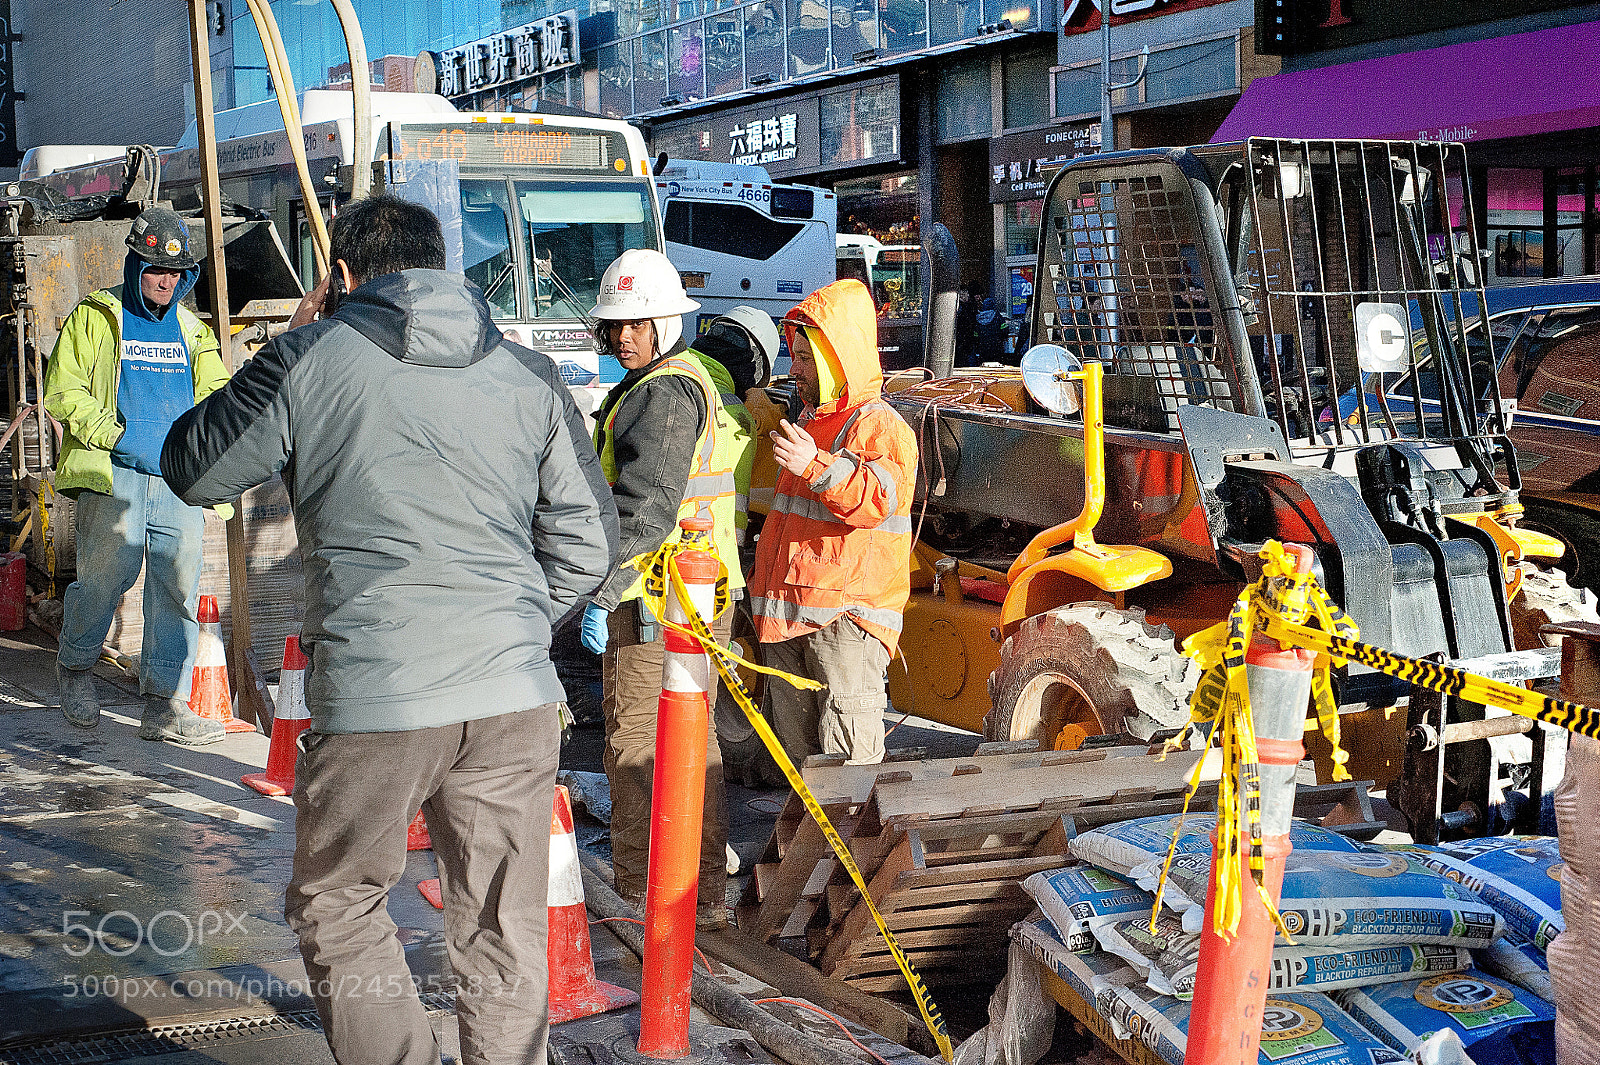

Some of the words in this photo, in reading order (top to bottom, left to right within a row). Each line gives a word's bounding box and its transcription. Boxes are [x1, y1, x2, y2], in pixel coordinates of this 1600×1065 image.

[440, 15, 569, 96] 新世界商城
[493, 130, 572, 149] LAGUARDIA
[729, 113, 797, 156] 六福珠寶
[237, 142, 261, 161] Electric
[263, 140, 276, 156] Bus
[503, 149, 563, 164] AIRPORT
[759, 147, 797, 164] JEWELLERY
[709, 187, 721, 195] City
[738, 189, 770, 202] 4666
[604, 284, 616, 295] GEI
[1101, 893, 1145, 908] HIGH
[1307, 908, 1348, 937] HP
[1354, 910, 1443, 924] ECO-FRIENDLY
[1352, 924, 1394, 934] BLACKTOP
[1396, 924, 1425, 935] REPAIR
[1425, 925, 1441, 935] MIX
[1314, 948, 1402, 972] ECO-FRIENDLY
[1315, 969, 1356, 983] BLACKTOP
[1357, 966, 1386, 978] REPAIR
[1387, 964, 1403, 973] MIX
